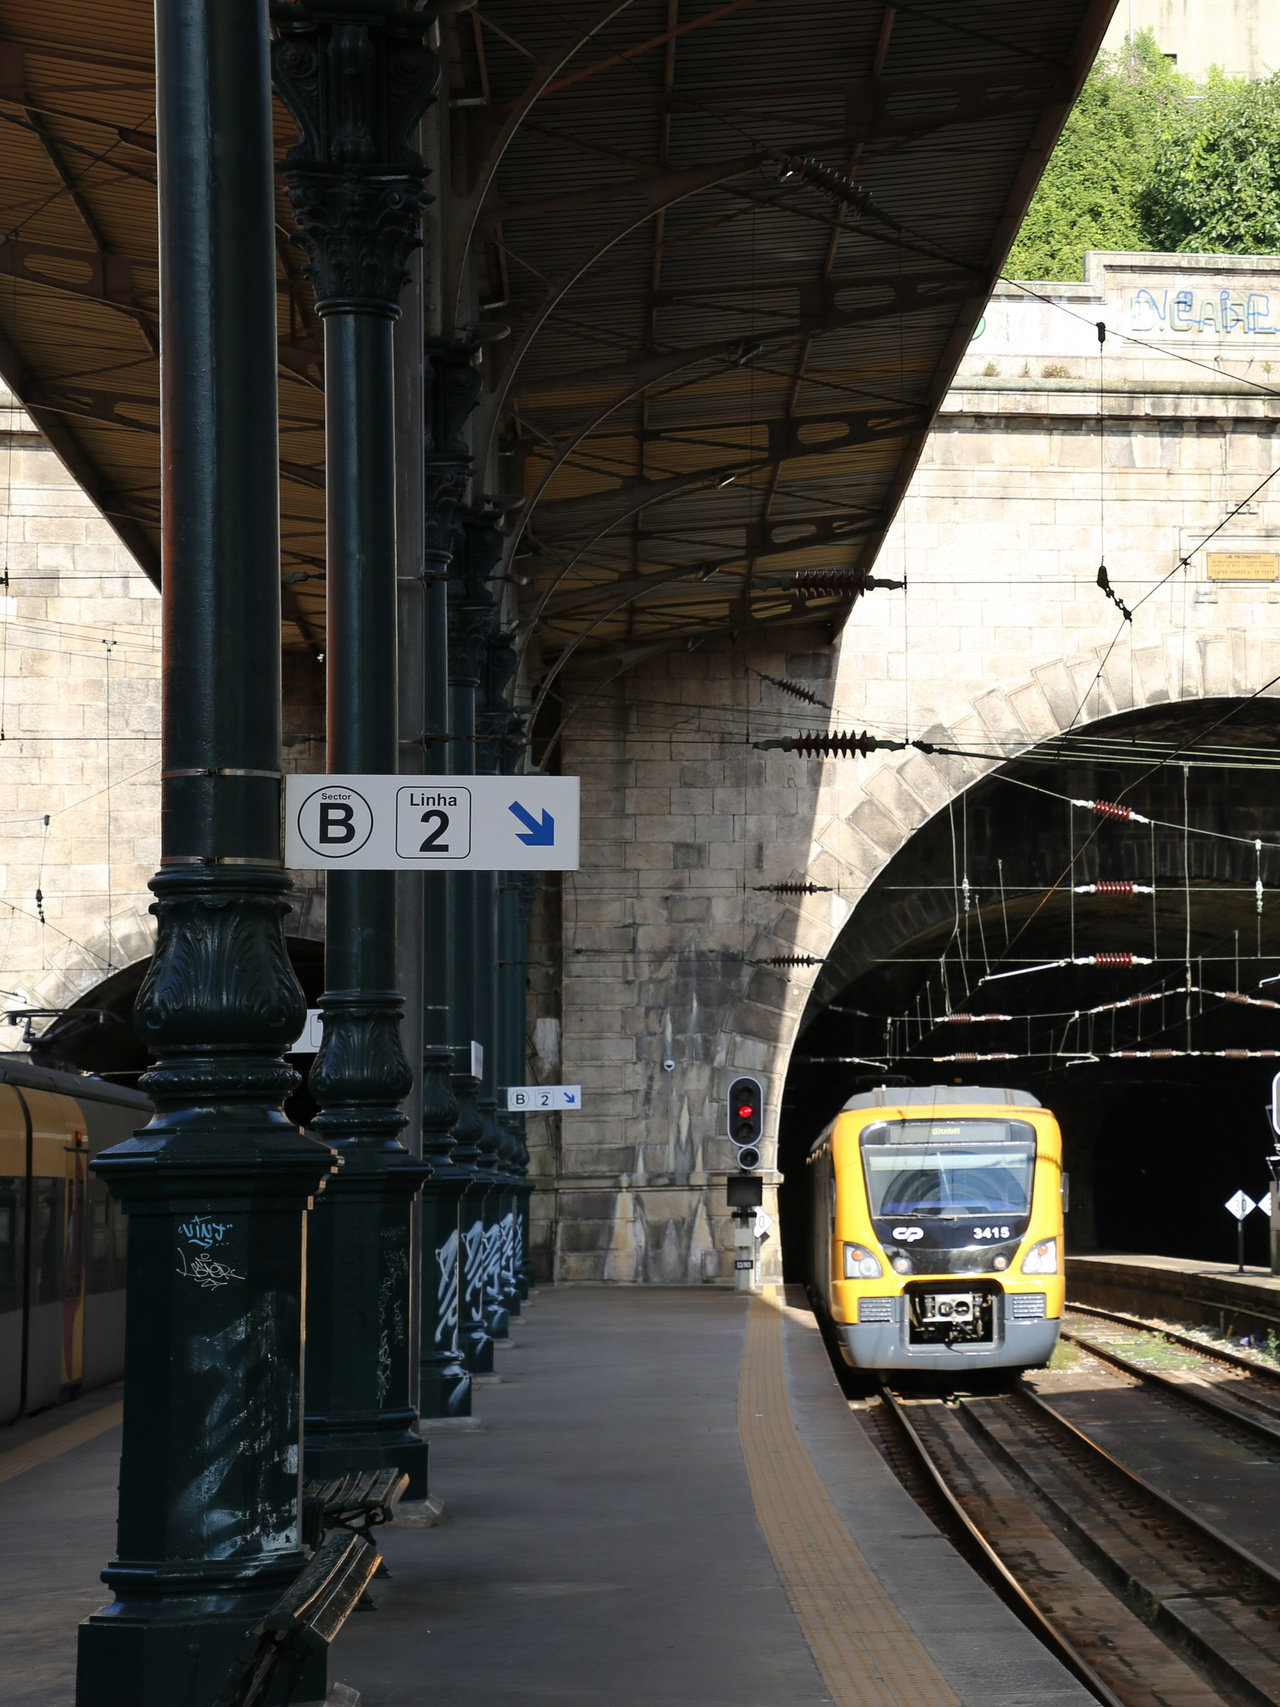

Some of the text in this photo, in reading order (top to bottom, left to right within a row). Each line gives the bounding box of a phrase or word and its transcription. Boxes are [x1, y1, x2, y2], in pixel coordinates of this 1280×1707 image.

[321, 792, 352, 801] Sector
[409, 792, 457, 808] Linha
[318, 802, 356, 845] B
[418, 809, 449, 853] 2
[516, 1094, 526, 1105] B
[541, 1095, 549, 1106] 2
[973, 1226, 1010, 1239] 3415
